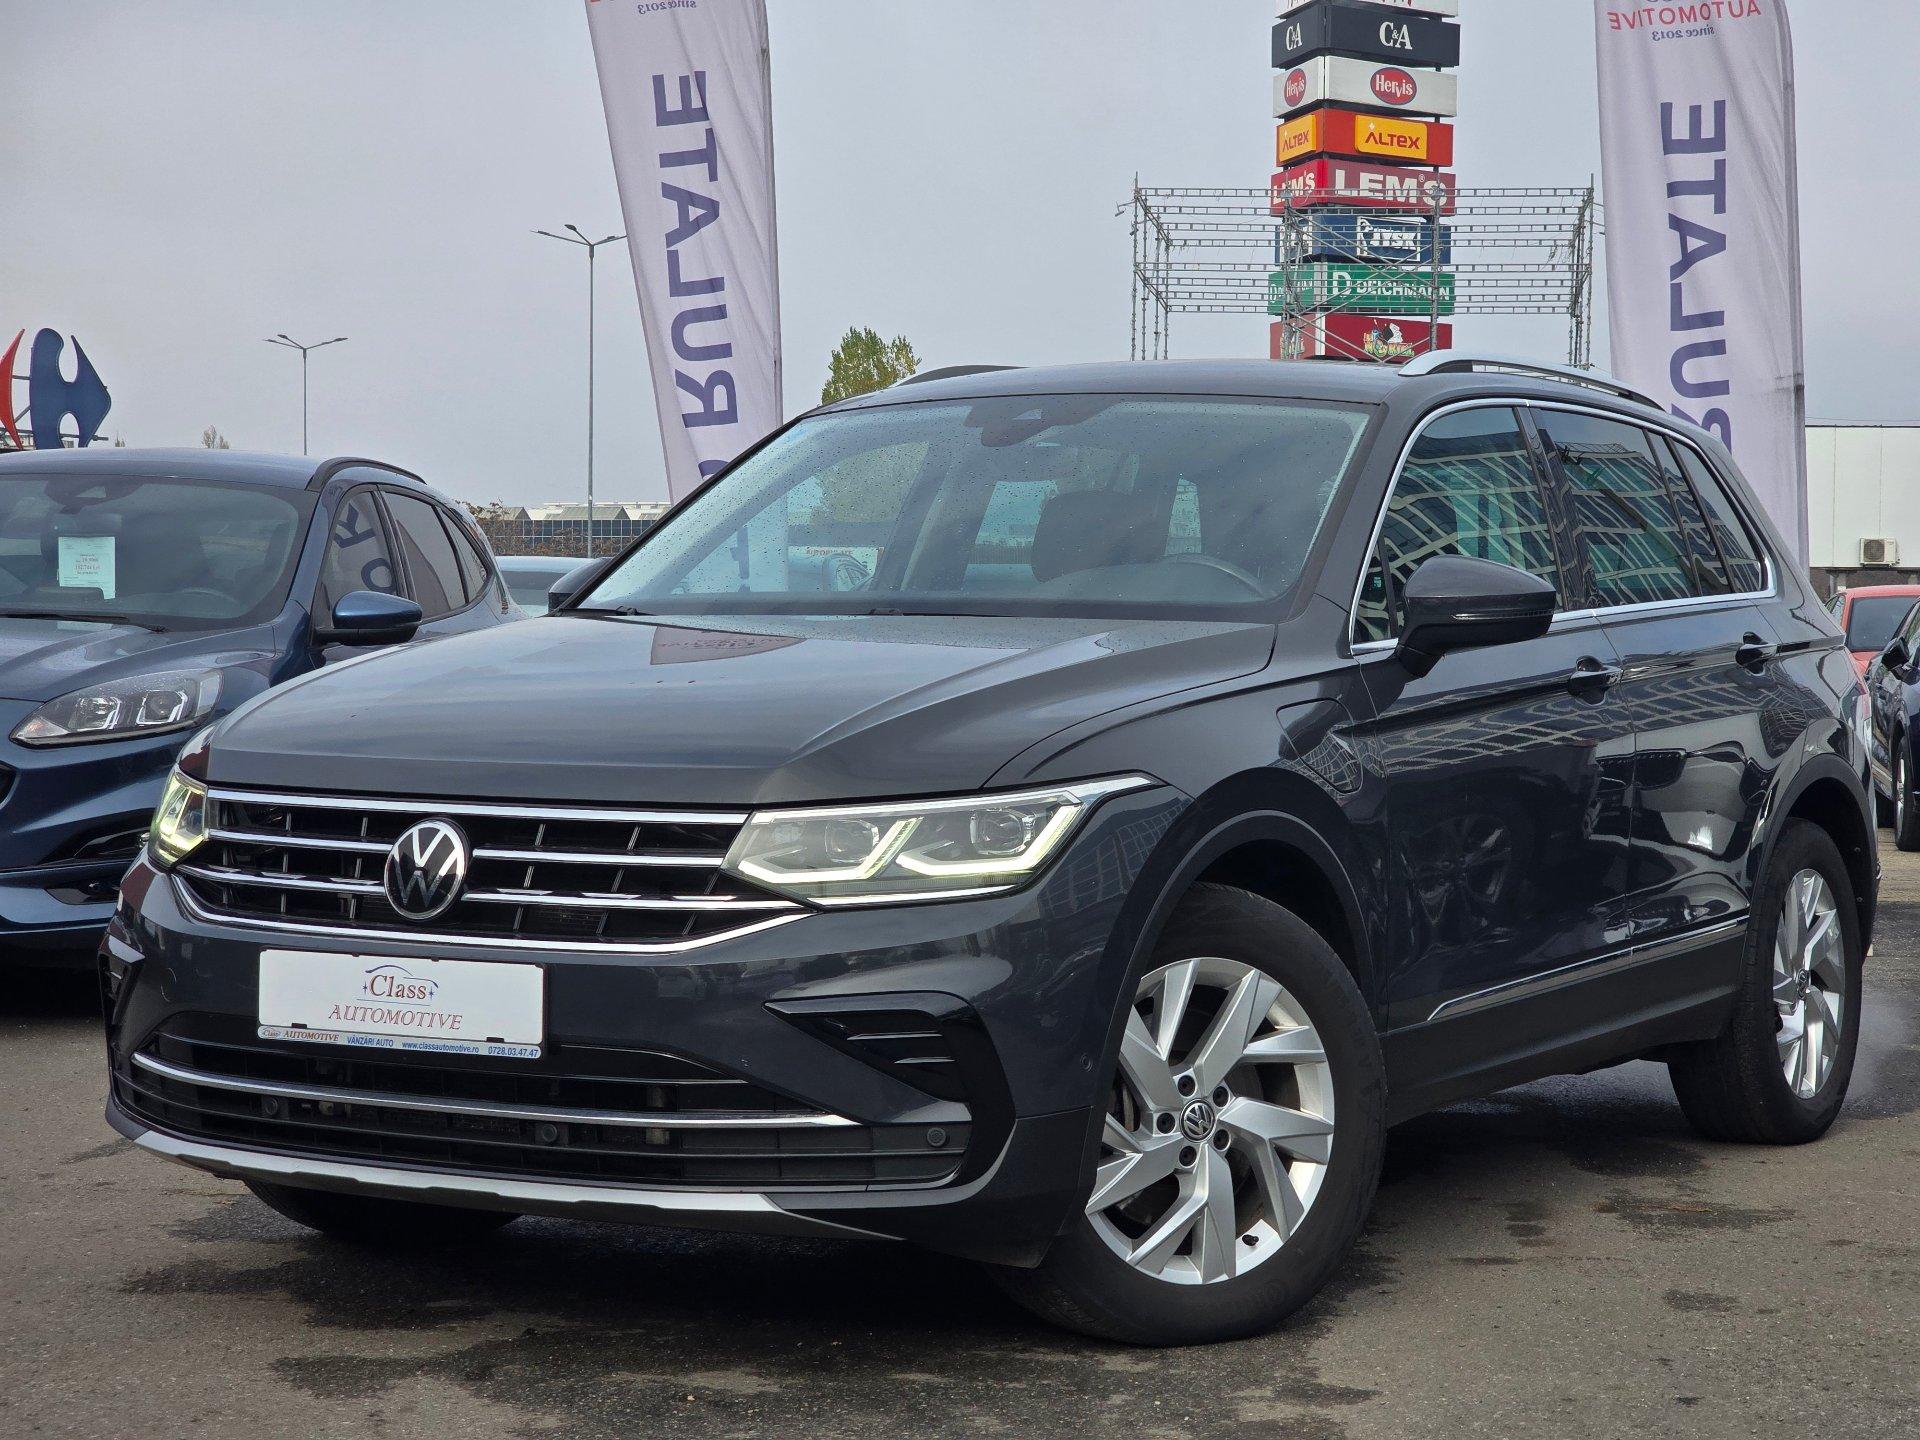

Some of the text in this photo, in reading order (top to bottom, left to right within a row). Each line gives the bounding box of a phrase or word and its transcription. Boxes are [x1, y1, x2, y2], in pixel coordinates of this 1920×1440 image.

[1285, 22, 1303, 50] C&A
[1379, 21, 1413, 50] C&A
[1286, 75, 1305, 97] Hervis
[1375, 74, 1413, 98] Hervis
[369, 974, 427, 999] Class
[328, 1003, 463, 1031] AUTOMOTIVE
[283, 1030, 340, 1042] AUTOMOTIVE
[376, 1038, 394, 1047] AUTO
[401, 1041, 480, 1054] www.classautomotive.ro
[487, 1046, 539, 1058] 0728.03.47.47
